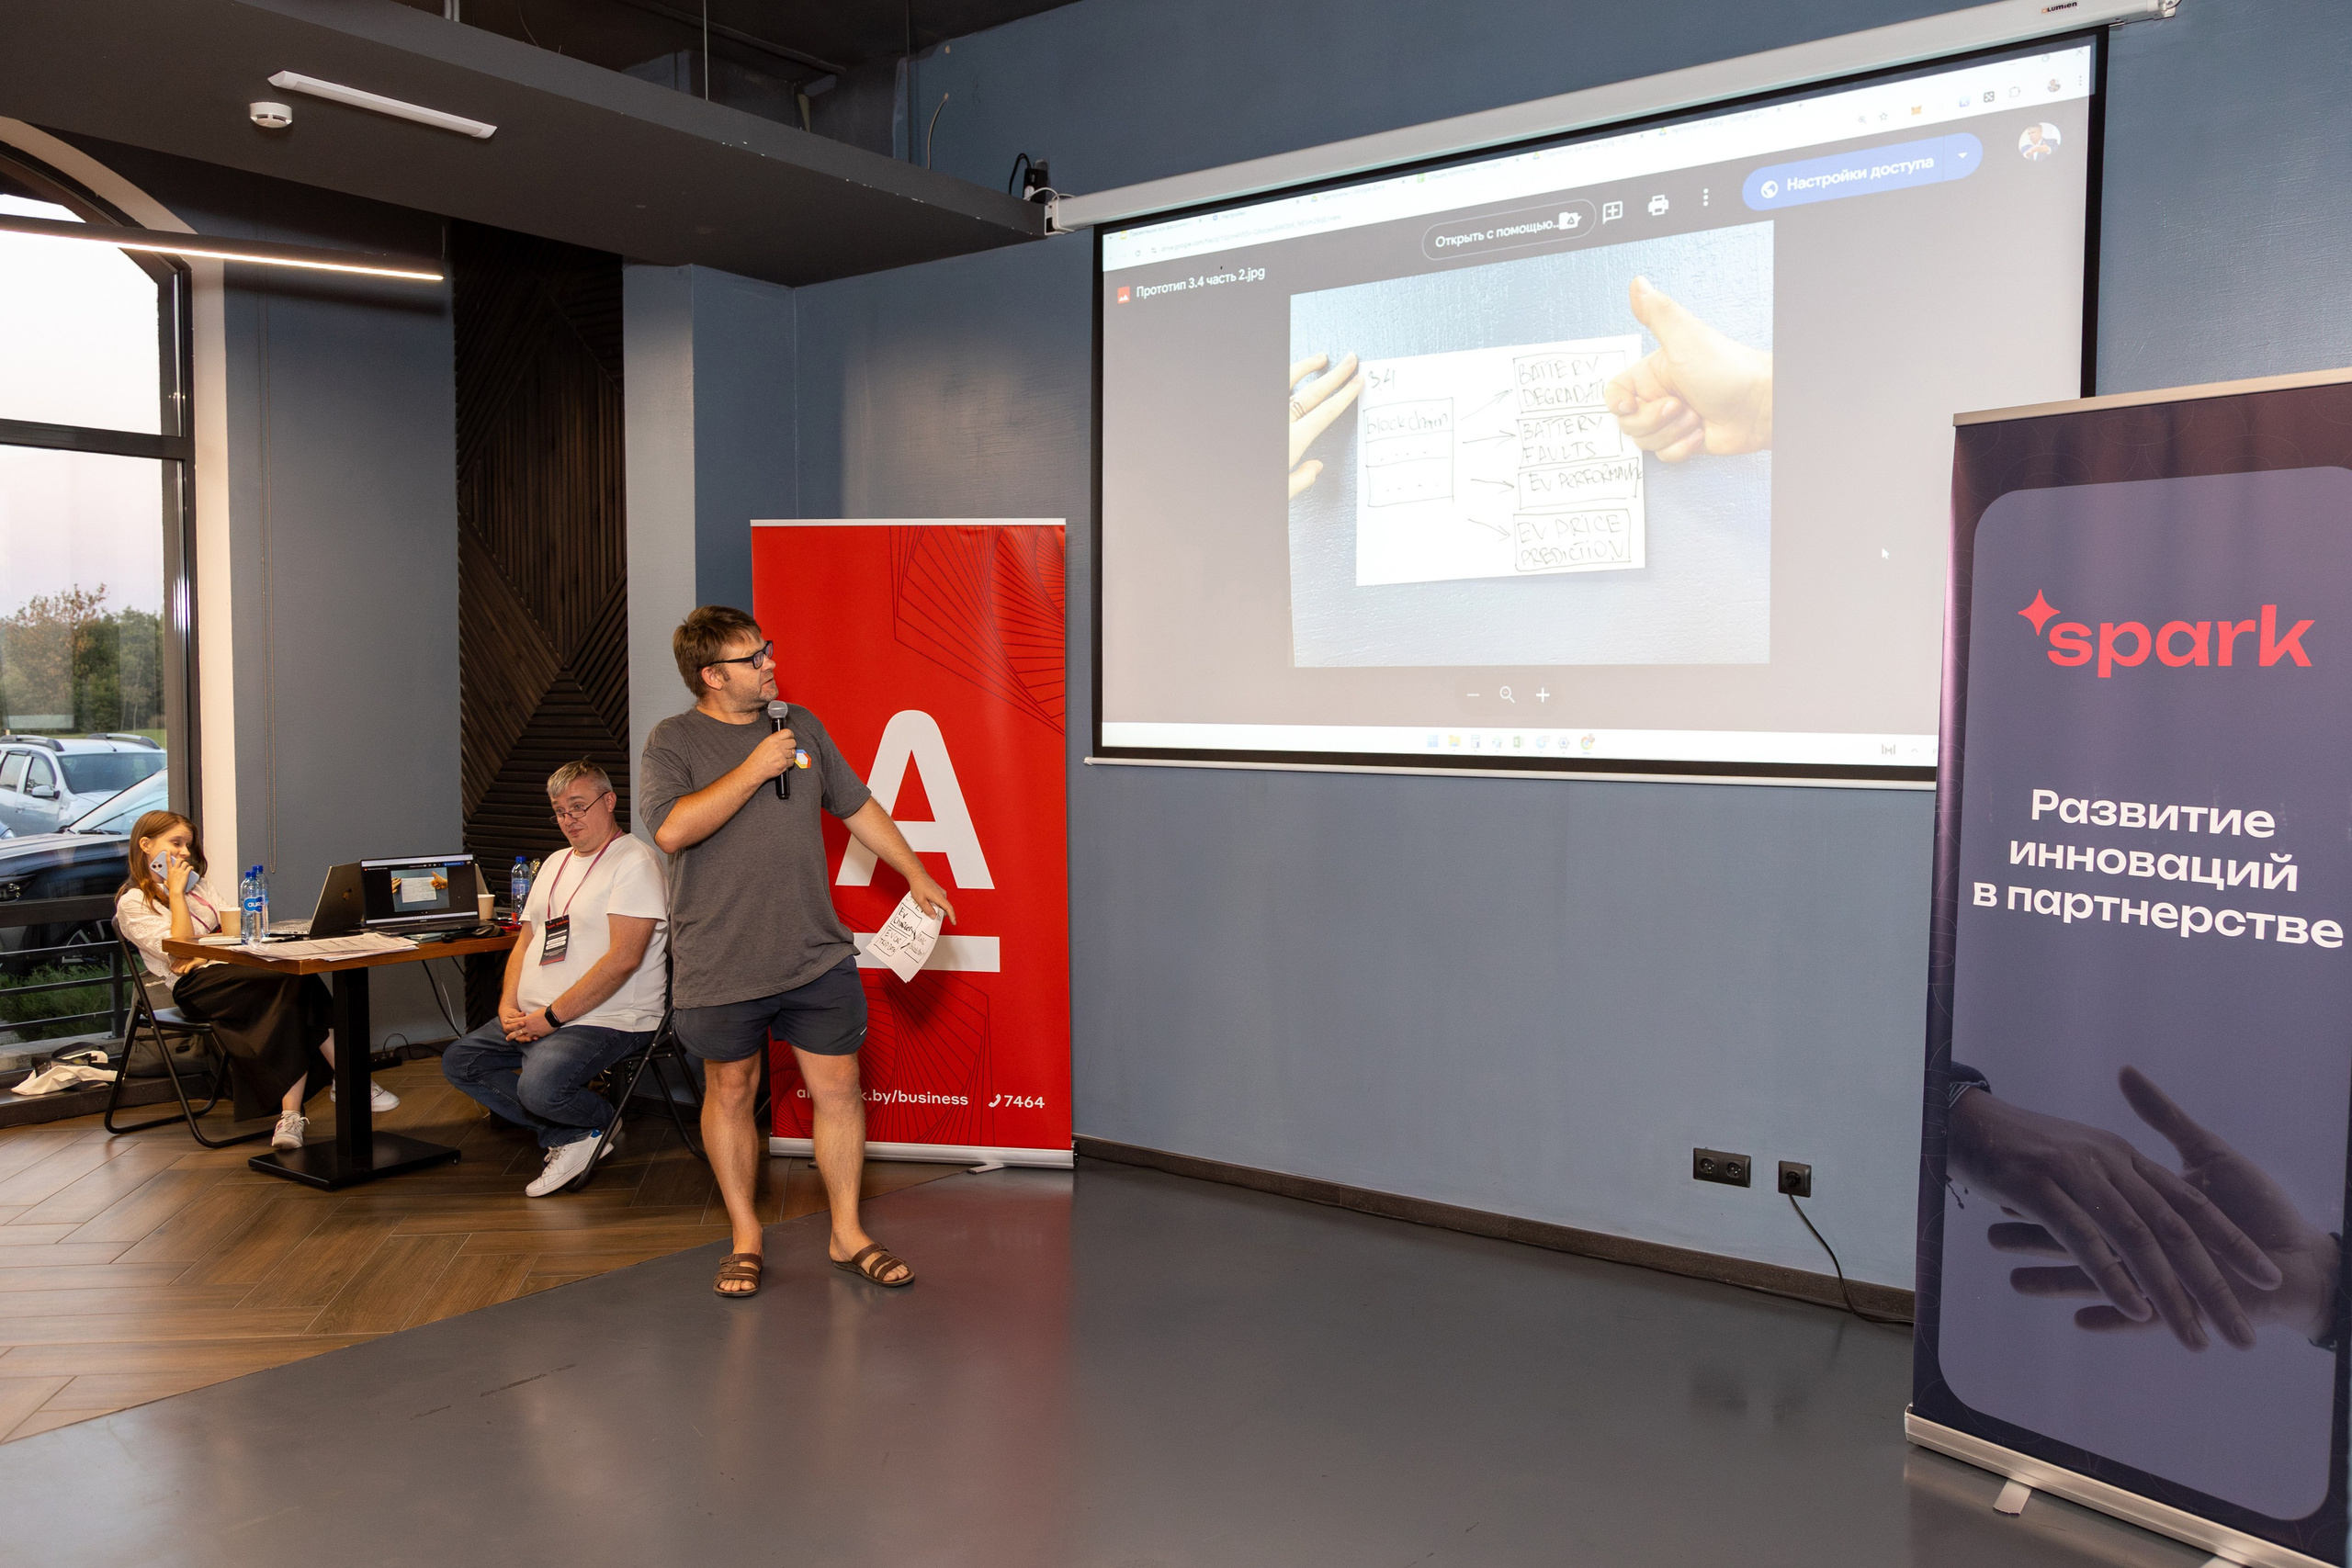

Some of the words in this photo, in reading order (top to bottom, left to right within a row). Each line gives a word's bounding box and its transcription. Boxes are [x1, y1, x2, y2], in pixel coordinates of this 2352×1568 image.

[1787, 169, 1867, 189] Настройки
[1870, 157, 1934, 180] доступа
[1435, 231, 1485, 248] Открыть
[1486, 230, 1494, 240] с
[1136, 280, 1186, 299] Прототип
[1188, 276, 1204, 289] 3.4
[1206, 272, 1237, 286] часть
[1238, 266, 1265, 281] 2.jpg
[1522, 378, 1605, 407] DEGRADATI
[1522, 441, 1596, 463] FAULTS
[1517, 522, 1546, 544] EV
[2047, 604, 2315, 678] spark
[834, 709, 995, 890] A
[2030, 788, 2276, 838] Развитие
[2009, 840, 2298, 892] инноваций
[1973, 882, 1997, 907] в
[2007, 885, 2344, 948] партнерстве
[1003, 1094, 1046, 1109] 7464
